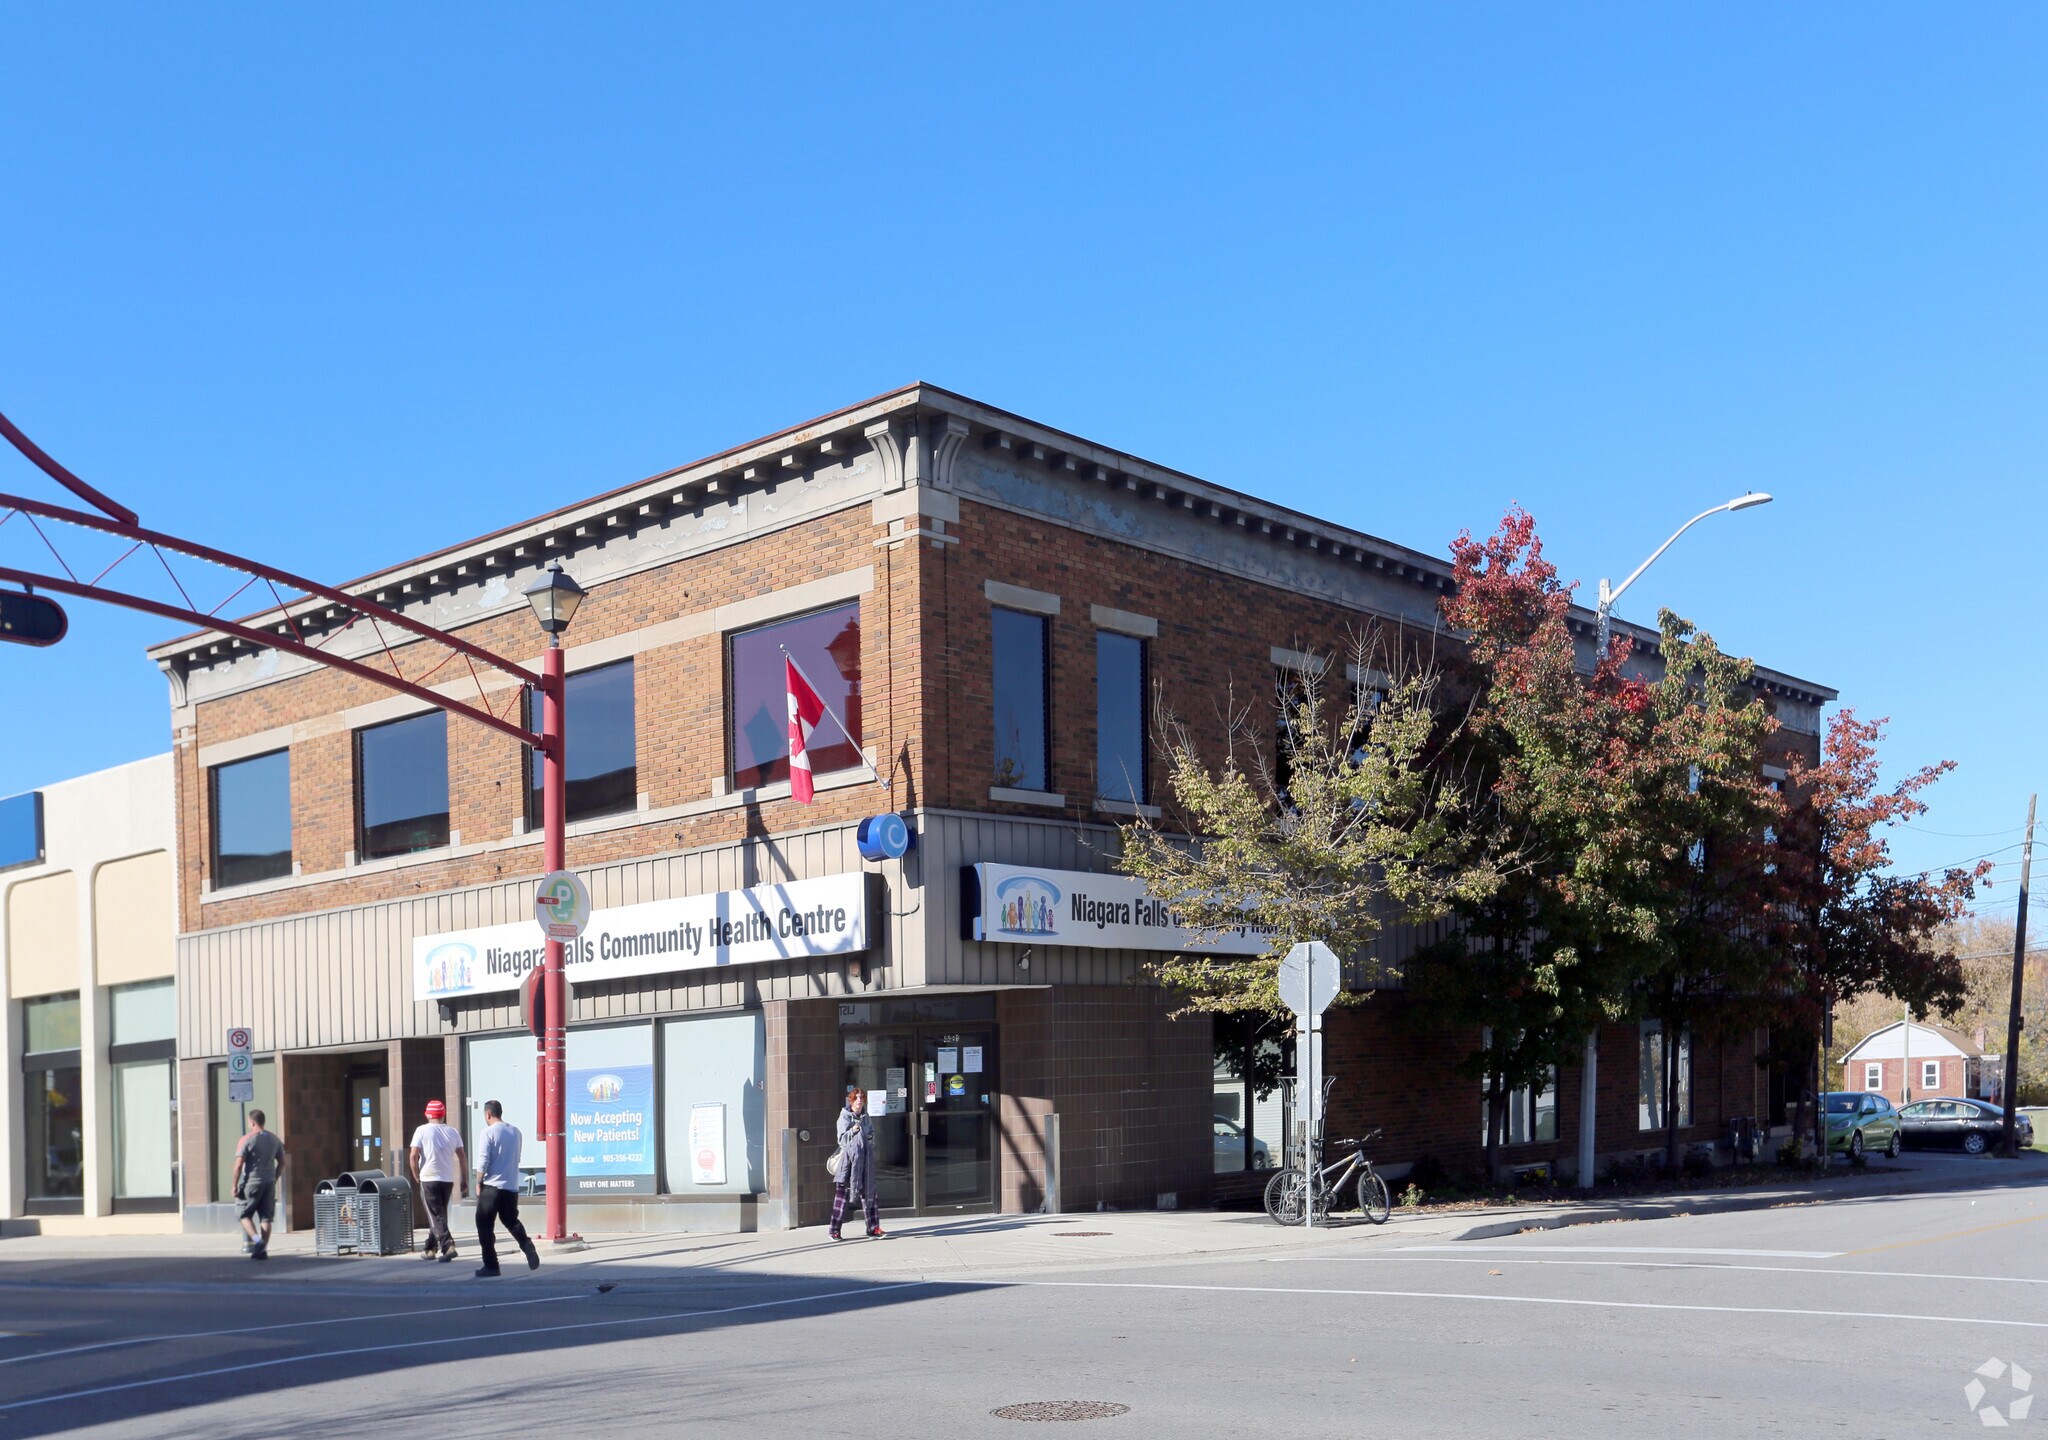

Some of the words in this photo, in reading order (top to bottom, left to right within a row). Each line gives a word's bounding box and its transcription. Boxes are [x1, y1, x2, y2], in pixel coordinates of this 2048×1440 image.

[1072, 893, 1130, 930] Niagara
[1135, 899, 1169, 928] Falls
[487, 947, 546, 978] Niagara
[565, 936, 594, 965] alls
[600, 921, 702, 961] Community
[709, 911, 772, 947] Health
[778, 904, 846, 939] Centre
[570, 1112, 592, 1126] Now
[594, 1110, 643, 1127] Accepting
[574, 1130, 594, 1143] New
[597, 1128, 640, 1142] Patients!
[580, 1180, 597, 1189] EVERY
[597, 1180, 609, 1188] ONE
[610, 1179, 635, 1188] MATTERS
